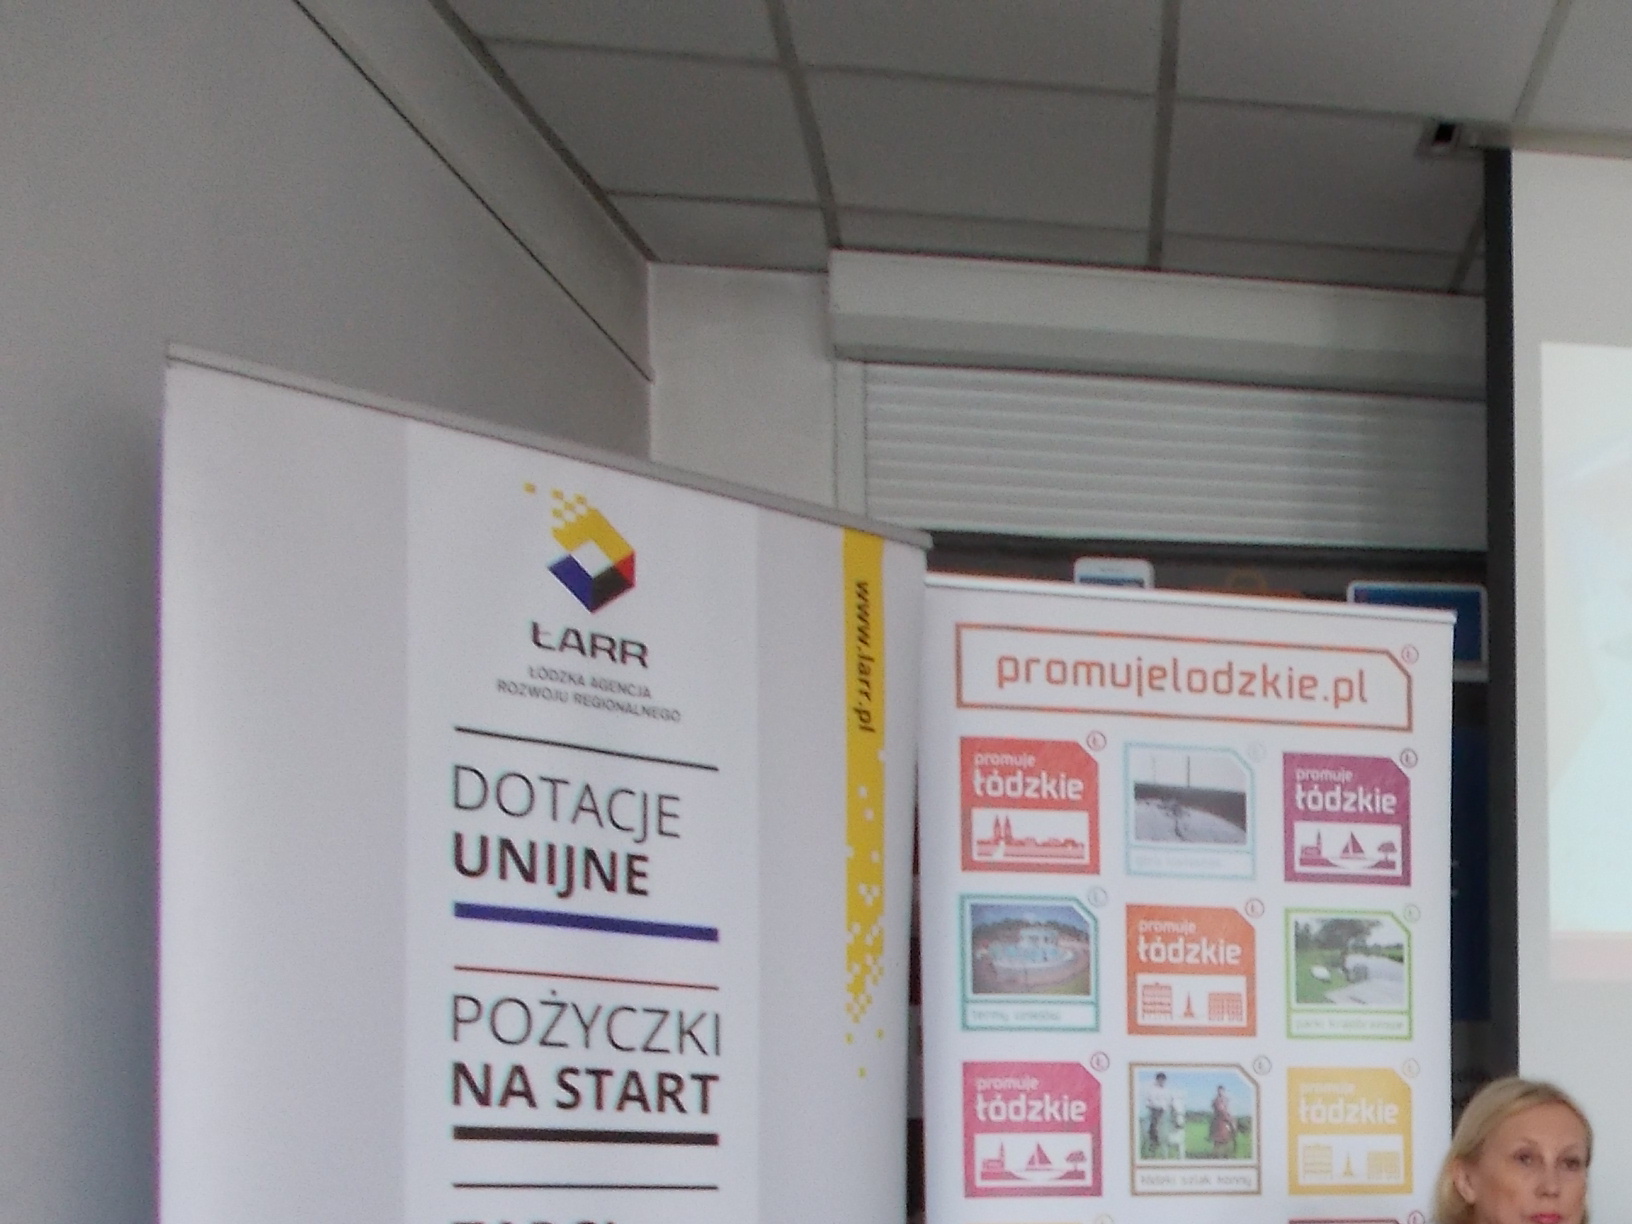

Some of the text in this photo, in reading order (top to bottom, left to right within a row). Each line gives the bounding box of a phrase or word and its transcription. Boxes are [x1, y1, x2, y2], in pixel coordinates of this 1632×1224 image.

[531, 621, 648, 668] ŁARR
[855, 581, 874, 733] www.larr.pl
[590, 677, 652, 699] AGENCJA
[998, 653, 1368, 709] promujelodzkie.pl
[574, 692, 681, 723] REGIONALNEGO
[973, 751, 1036, 770] promuje
[1296, 767, 1353, 785] promuje
[973, 769, 1084, 801] łódzkie
[1295, 782, 1397, 815] łódzkie
[453, 765, 680, 843] DOTACJE
[453, 832, 649, 898] UNIJNE
[1138, 919, 1196, 937] promuje
[1137, 936, 1242, 966] łódzkie
[452, 990, 720, 1056] POŻYCZKI
[452, 1062, 719, 1114] NA START
[975, 1075, 1039, 1093] promuje
[975, 1091, 1087, 1123] łódzkie
